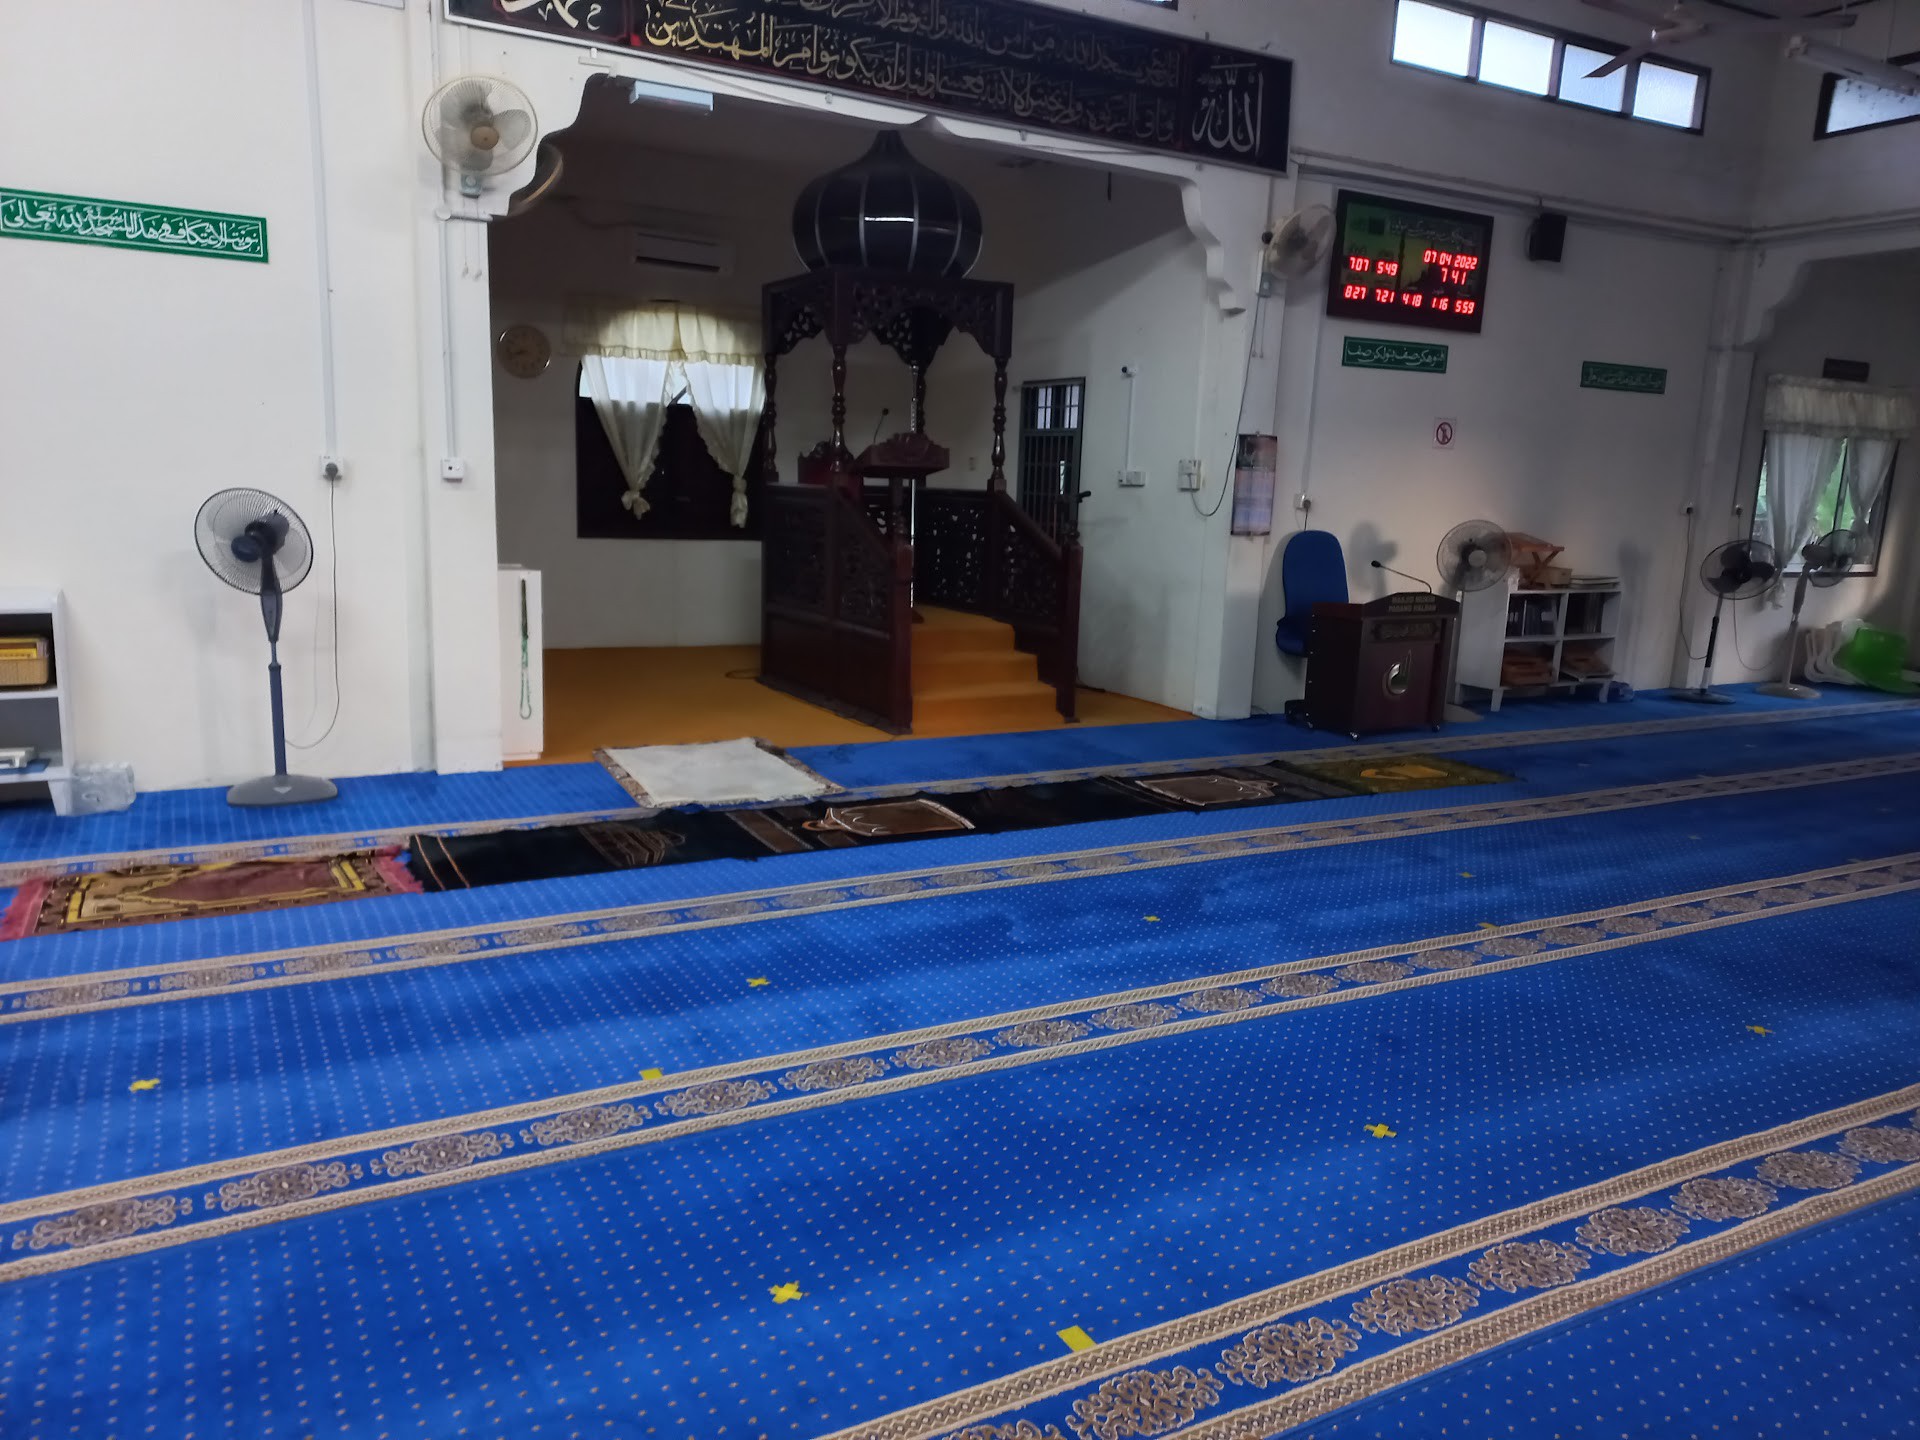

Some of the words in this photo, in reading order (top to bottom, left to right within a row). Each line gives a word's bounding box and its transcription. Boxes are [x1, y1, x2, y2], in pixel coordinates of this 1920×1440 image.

[1424, 249, 1437, 263] 07
[1439, 252, 1452, 265] 04
[1454, 254, 1478, 270] 2022
